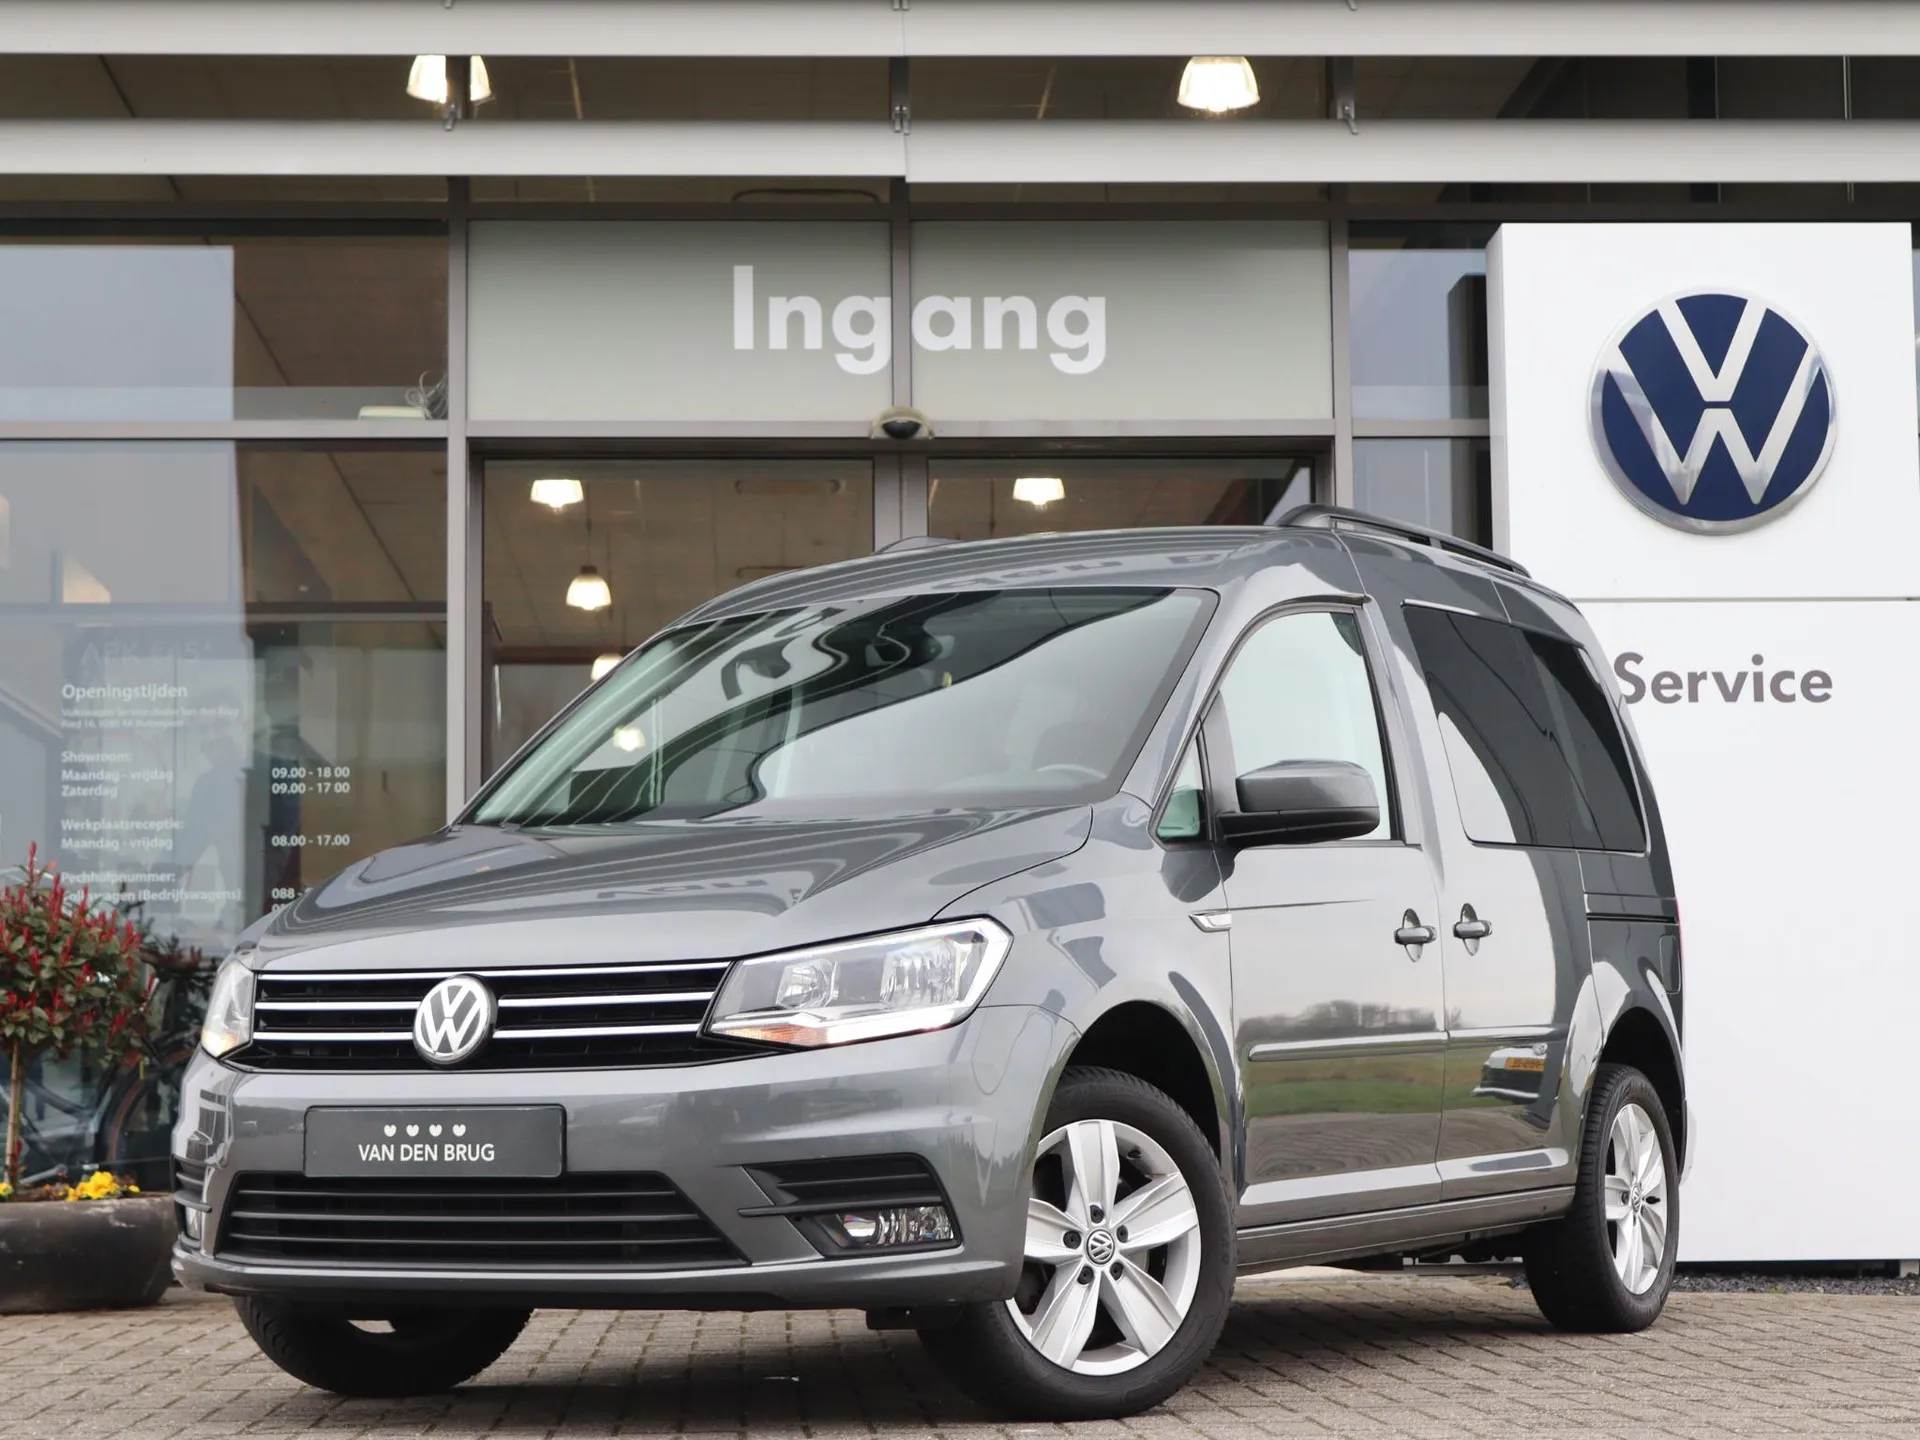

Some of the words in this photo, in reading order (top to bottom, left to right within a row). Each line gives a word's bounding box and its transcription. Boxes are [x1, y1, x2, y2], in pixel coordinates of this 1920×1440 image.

[733, 264, 1107, 375] Ingang
[1613, 651, 1834, 705] Service
[62, 683, 188, 701] Openingstijden
[61, 750, 132, 764] Showroom:
[61, 769, 120, 784] Maandag
[130, 768, 173, 784] vrijdag
[271, 767, 306, 779] 09.00
[317, 766, 350, 778] 1800
[61, 784, 118, 799] Zaterdag
[271, 782, 306, 794] 09.00
[317, 782, 350, 793] 1700
[61, 837, 120, 852] Maandag
[130, 837, 173, 851] vrijdag
[271, 835, 306, 847] 08.00
[317, 834, 350, 846] 17.00
[271, 888, 296, 899] 088
[358, 1144, 395, 1161] VAN
[400, 1144, 438, 1161] DEN
[444, 1143, 495, 1162] BRUG
